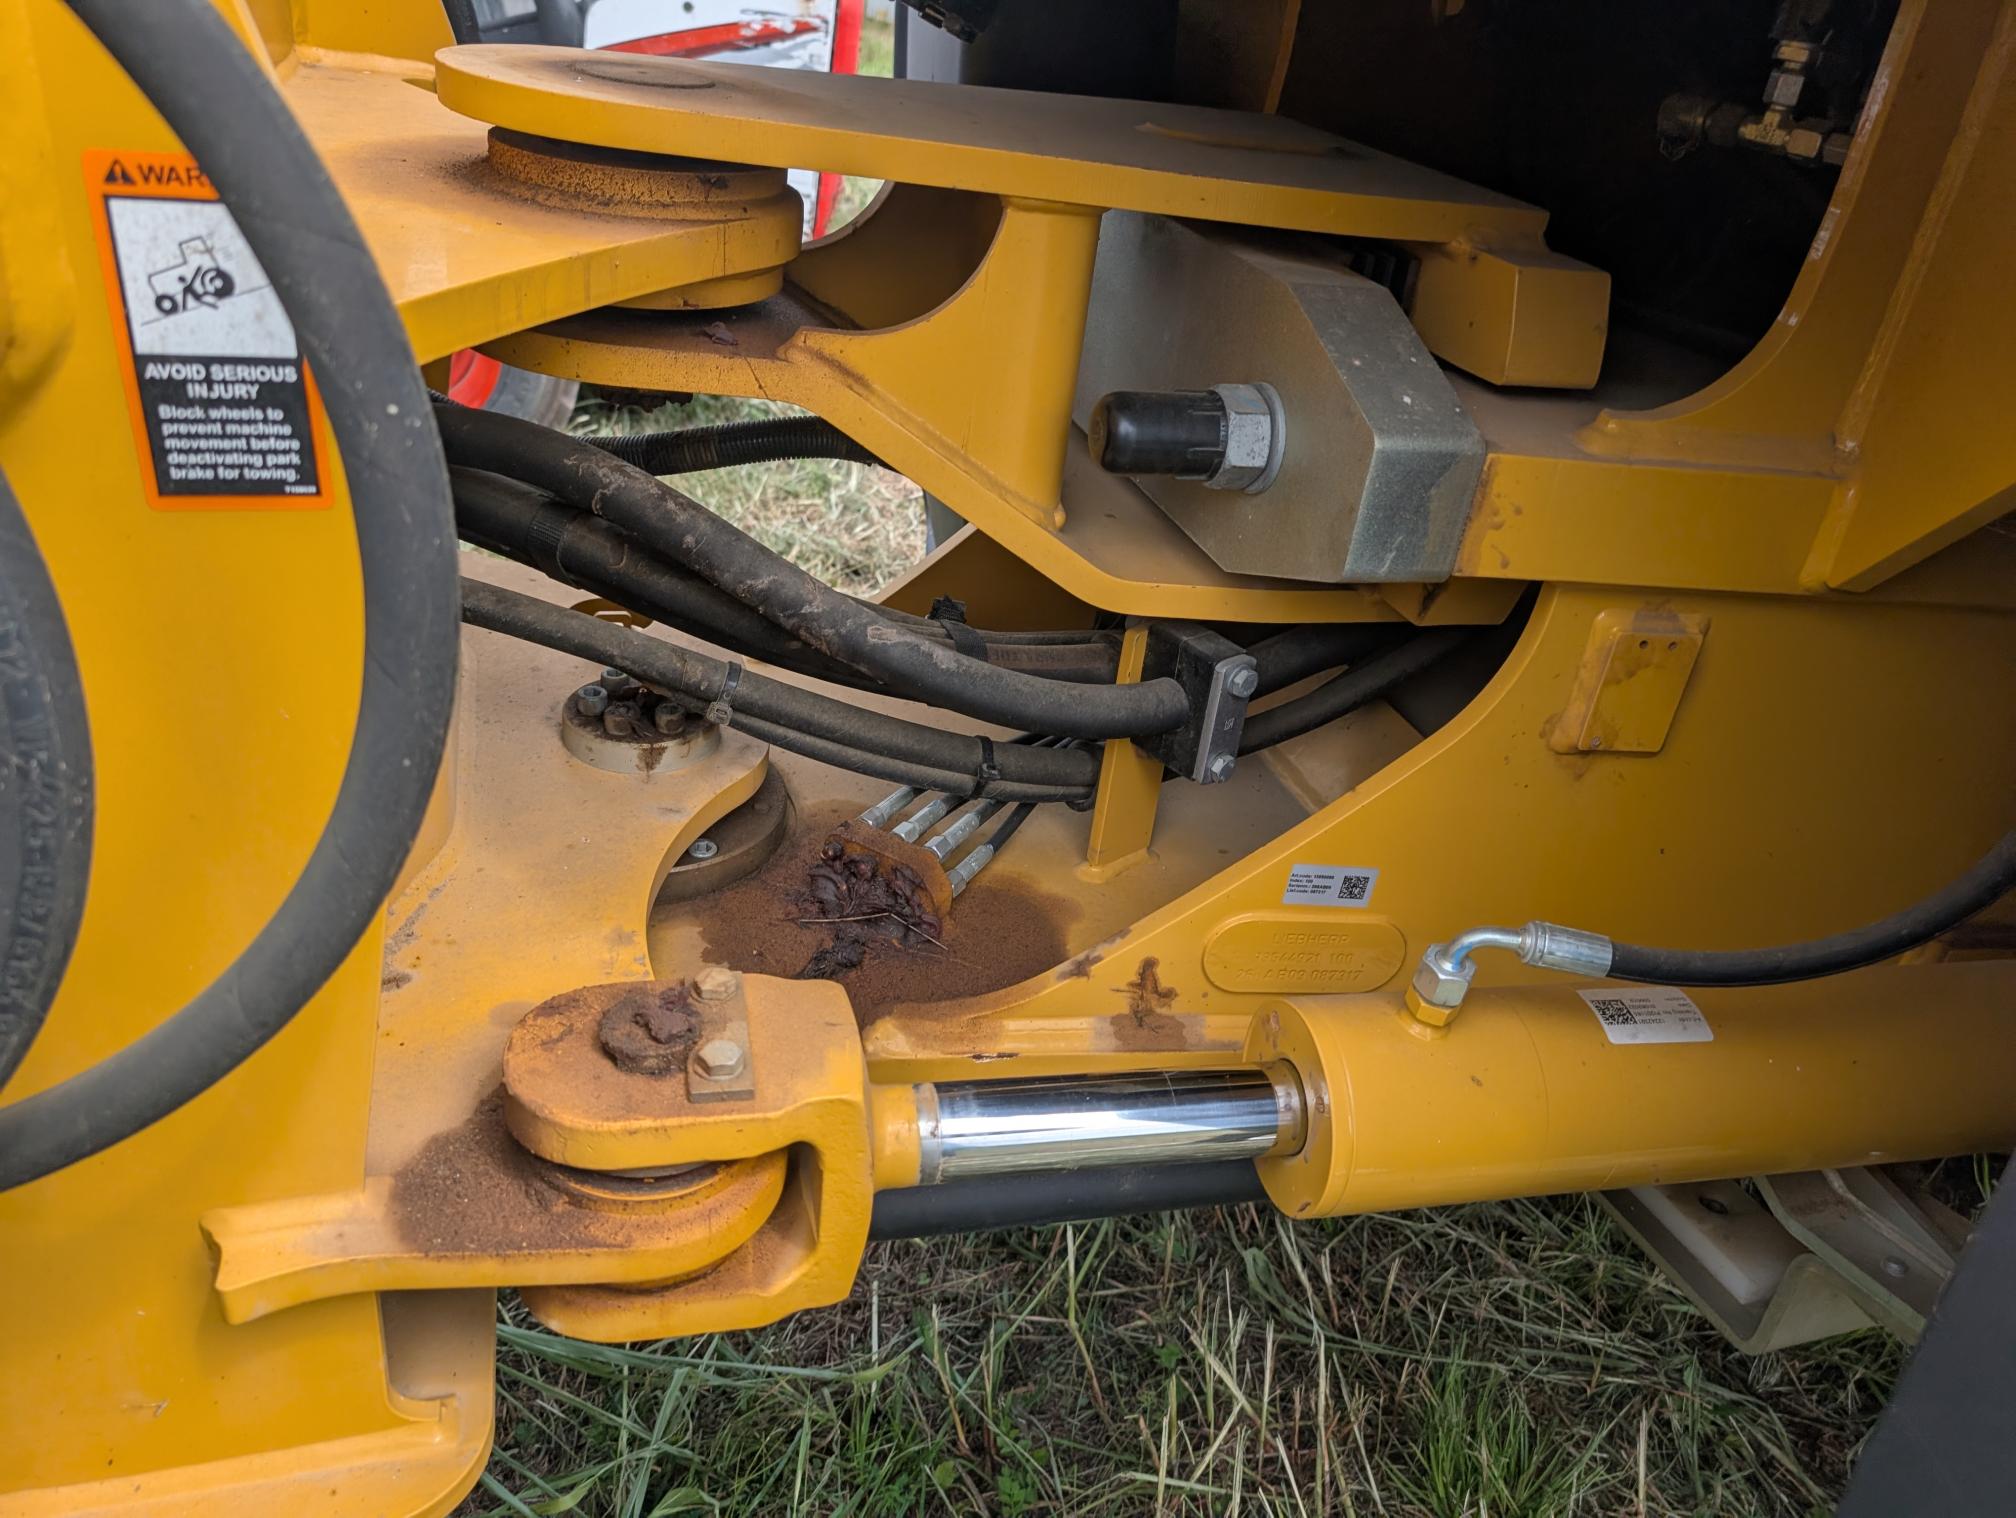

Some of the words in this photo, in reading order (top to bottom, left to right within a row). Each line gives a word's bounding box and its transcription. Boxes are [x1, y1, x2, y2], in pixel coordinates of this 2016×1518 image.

[144, 363, 207, 380] AVOID
[209, 364, 298, 383] SERIOUS
[186, 382, 259, 400] INJURY
[158, 404, 206, 420] Block
[208, 405, 264, 421] wheels
[266, 407, 284, 421] to
[161, 422, 223, 437] prevent
[225, 422, 292, 436] machine
[164, 437, 248, 450] movement
[250, 437, 300, 451] before
[167, 451, 263, 467] deactivating
[266, 453, 301, 467] park
[169, 466, 215, 480] brake
[217, 466, 241, 480] for
[243, 466, 300, 483] towing.
[1272, 932, 1351, 946] LIEBHERR
